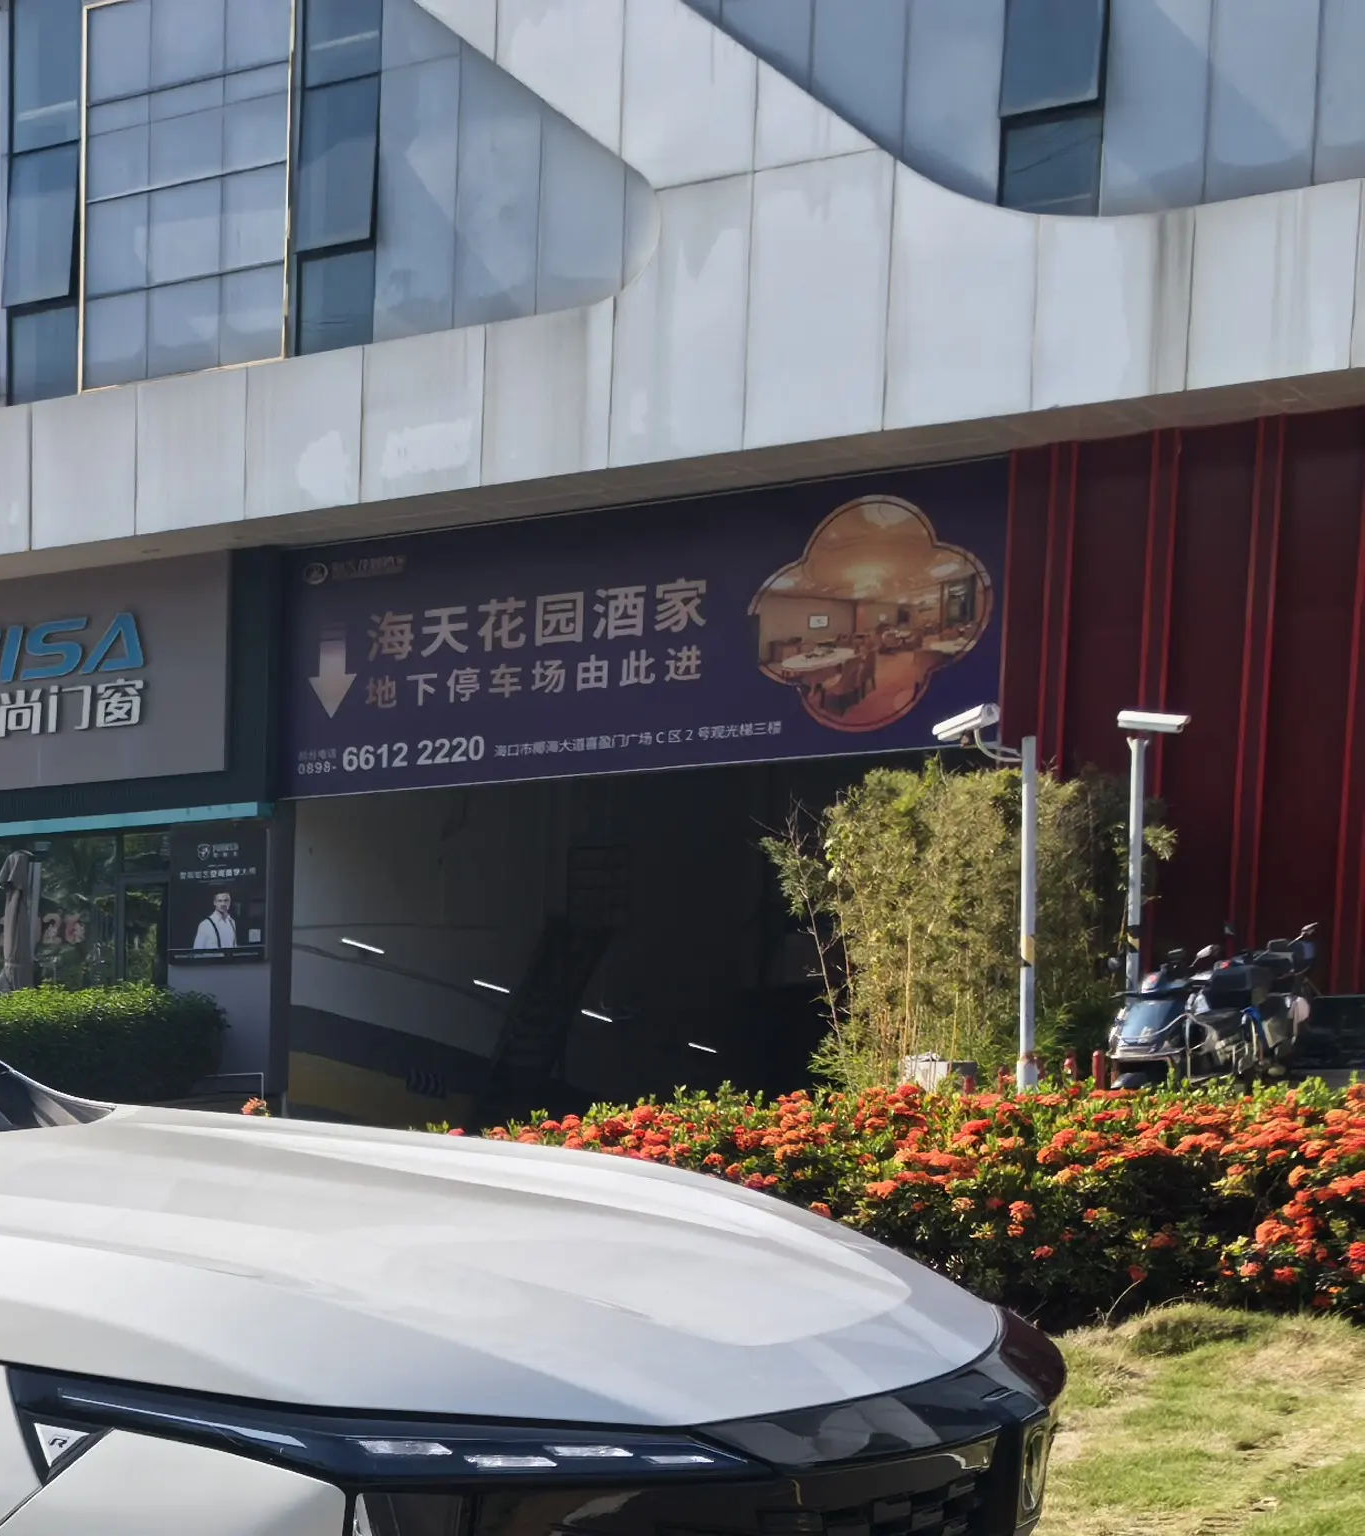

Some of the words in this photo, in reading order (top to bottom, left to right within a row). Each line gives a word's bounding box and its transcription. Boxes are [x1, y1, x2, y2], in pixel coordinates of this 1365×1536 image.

[367, 577, 707, 662] 海天花园酒家
[365, 645, 702, 709] 地下停车场由此进
[342, 742, 409, 772] 6612
[416, 735, 485, 766] 2220
